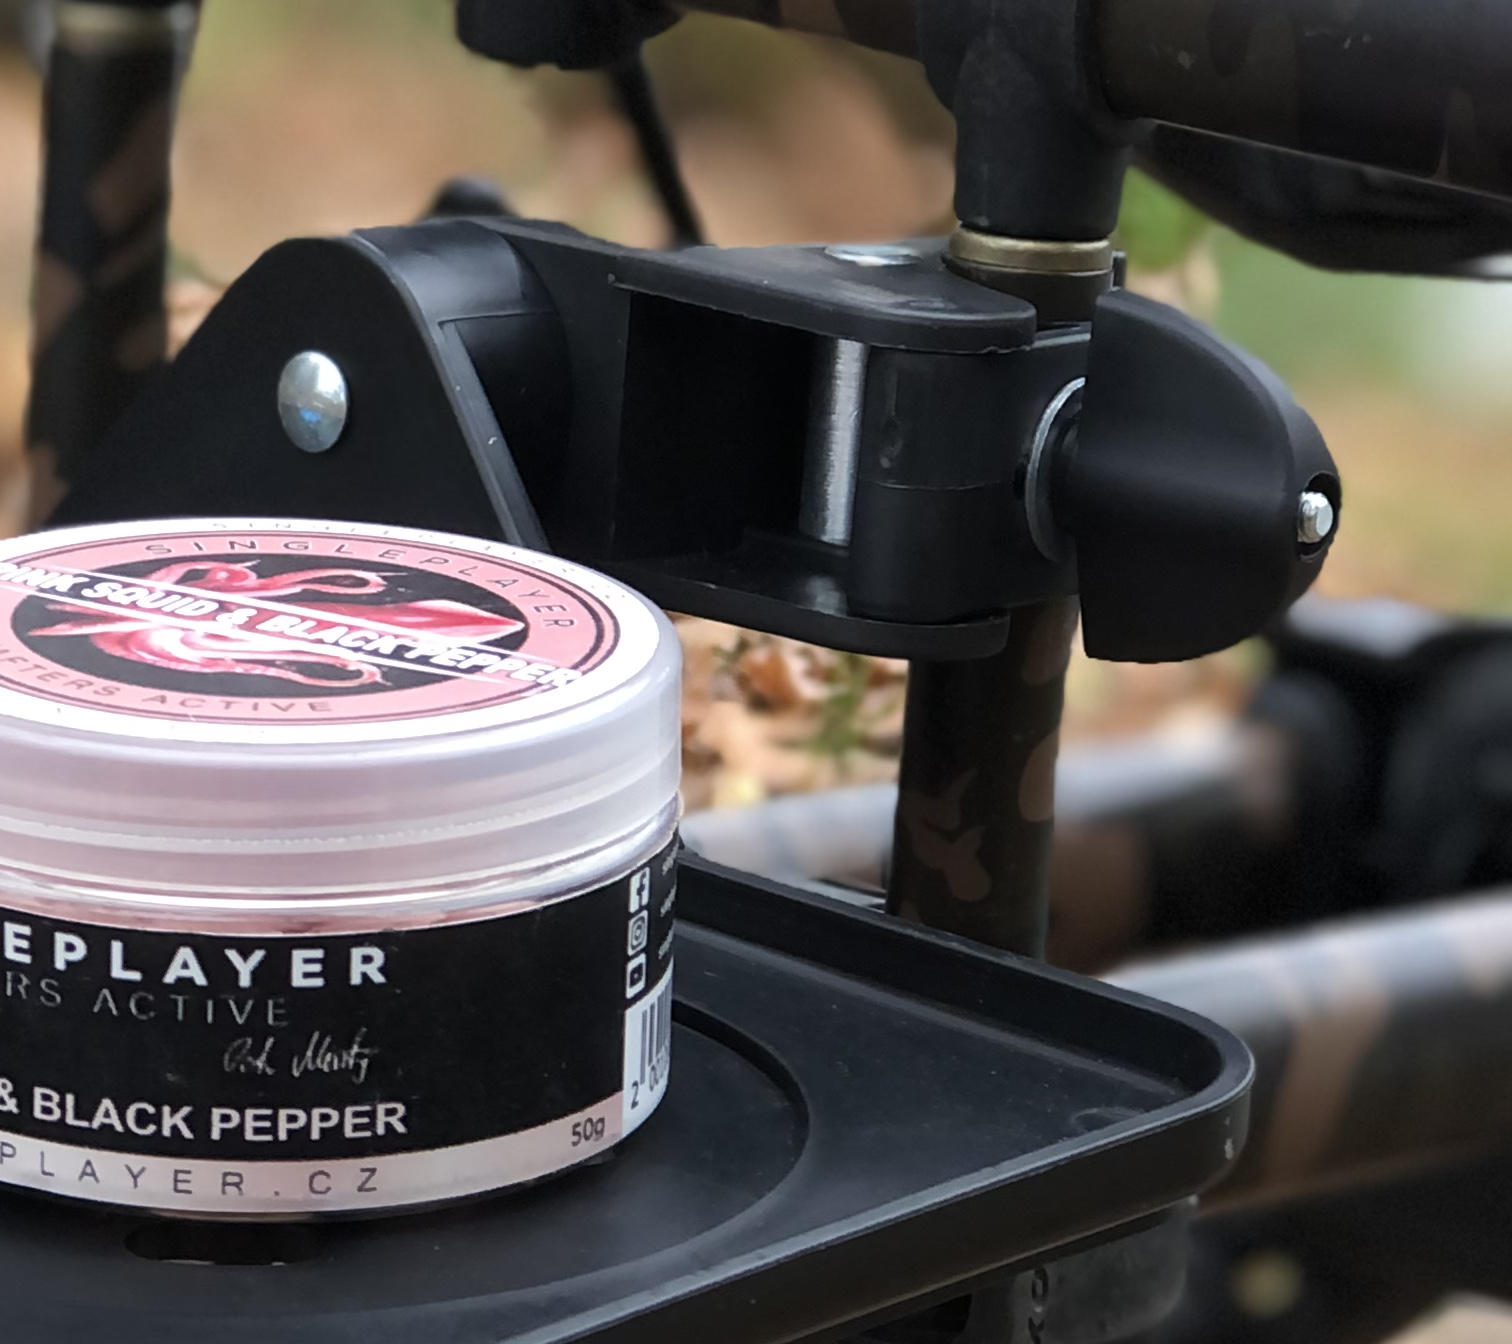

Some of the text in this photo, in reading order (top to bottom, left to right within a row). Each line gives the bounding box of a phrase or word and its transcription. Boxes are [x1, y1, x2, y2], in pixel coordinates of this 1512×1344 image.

[144, 538, 576, 629] SINGLEPLAYER
[81, 581, 219, 617] SQUID
[216, 607, 257, 629] &
[256, 614, 401, 654] BLACK
[402, 641, 583, 689] PEPPER
[141, 693, 334, 713] ACTIVE
[93, 987, 289, 1027] ACTIVE
[33, 1086, 195, 1140] BLACK
[209, 1101, 408, 1142] PEPPER
[571, 1115, 607, 1148] 50g
